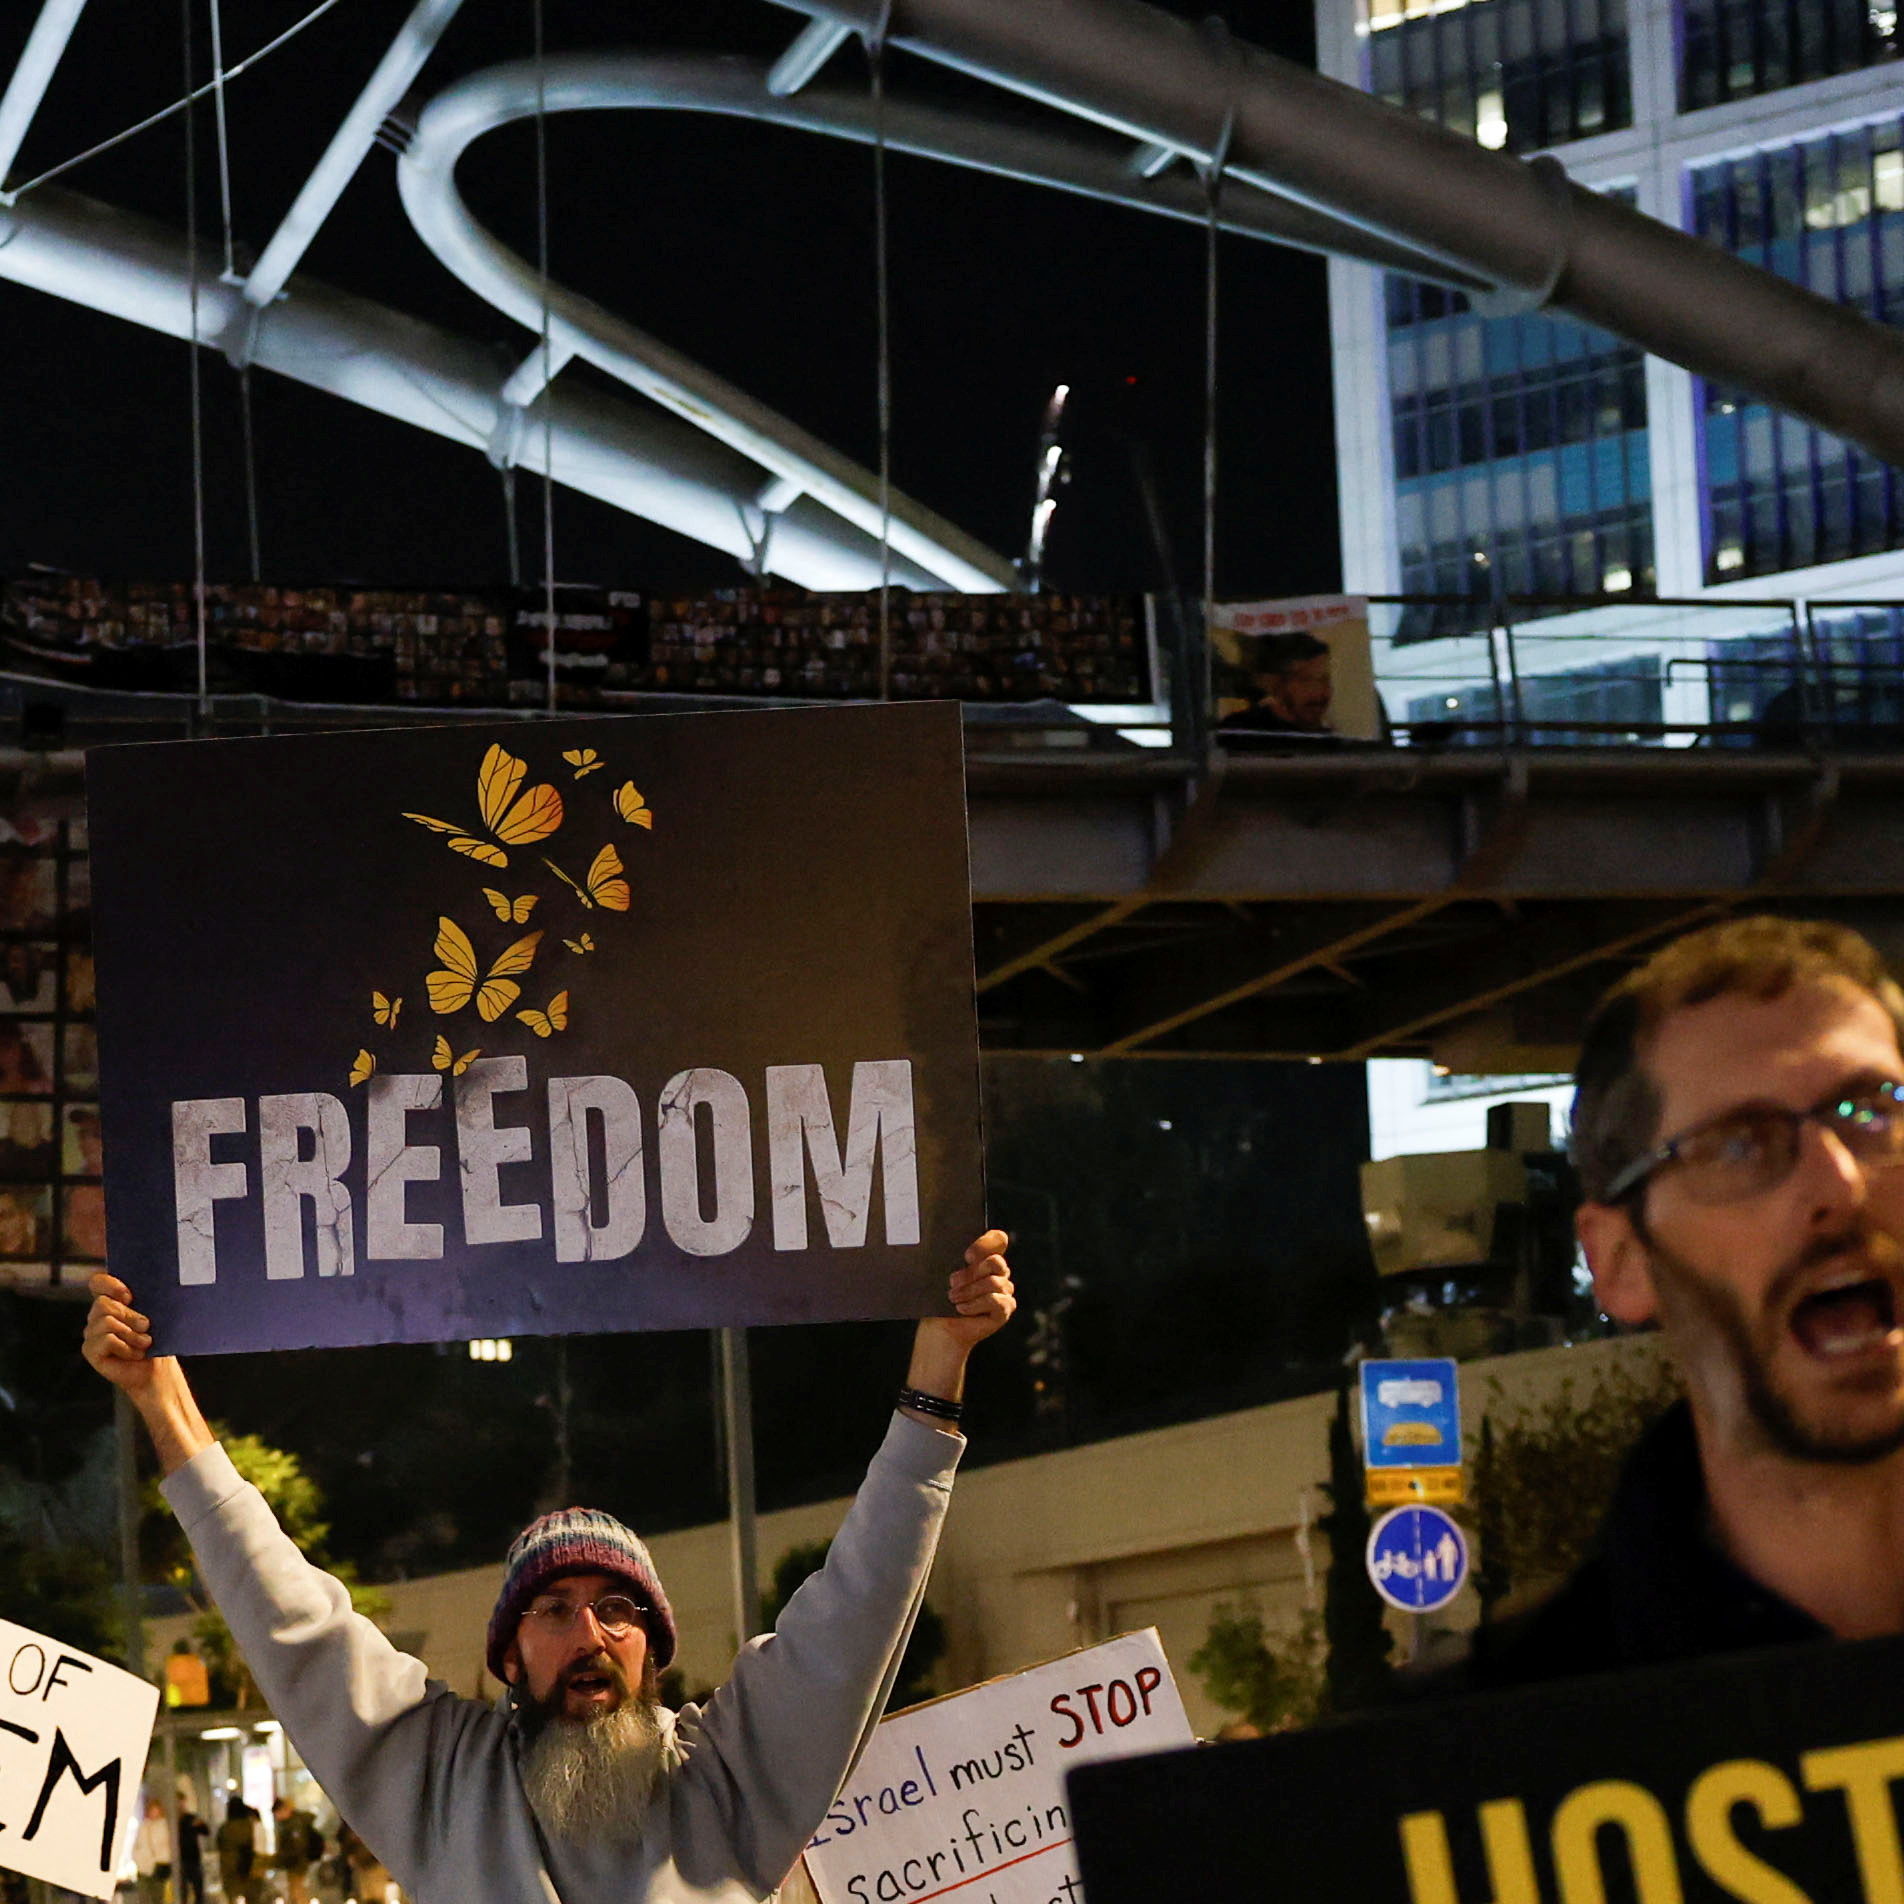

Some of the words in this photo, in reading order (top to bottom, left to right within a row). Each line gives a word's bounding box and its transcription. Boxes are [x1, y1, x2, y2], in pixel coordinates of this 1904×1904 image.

[173, 1055, 920, 1285] FREEDOM
[8, 1643, 94, 1702] OF
[806, 1745, 937, 1850] srael
[949, 1723, 1035, 1791] must
[1050, 1666, 1162, 1749] STOP
